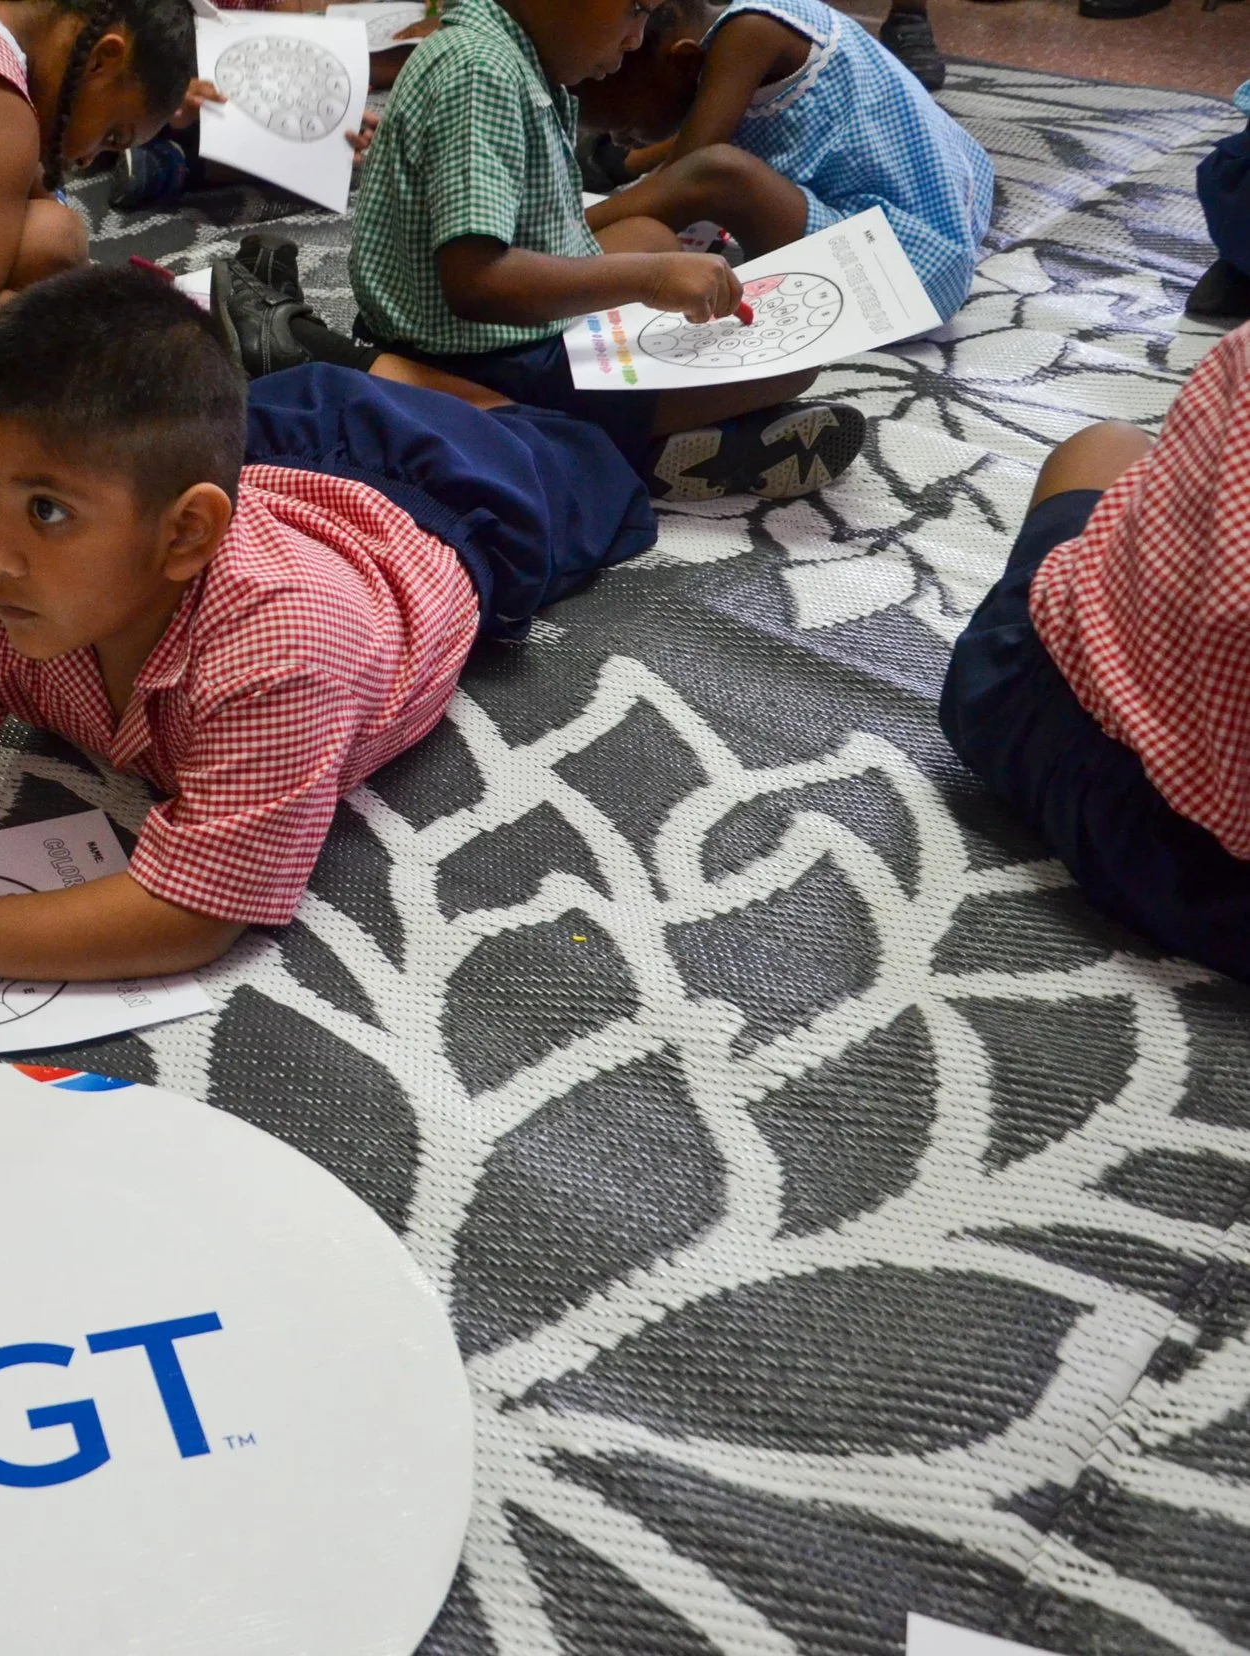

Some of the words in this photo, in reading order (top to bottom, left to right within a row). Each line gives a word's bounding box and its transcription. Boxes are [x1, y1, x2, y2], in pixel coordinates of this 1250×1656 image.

[43, 838, 86, 888] COLOR
[23, 987, 36, 996] E
[223, 1432, 257, 1450] TM
